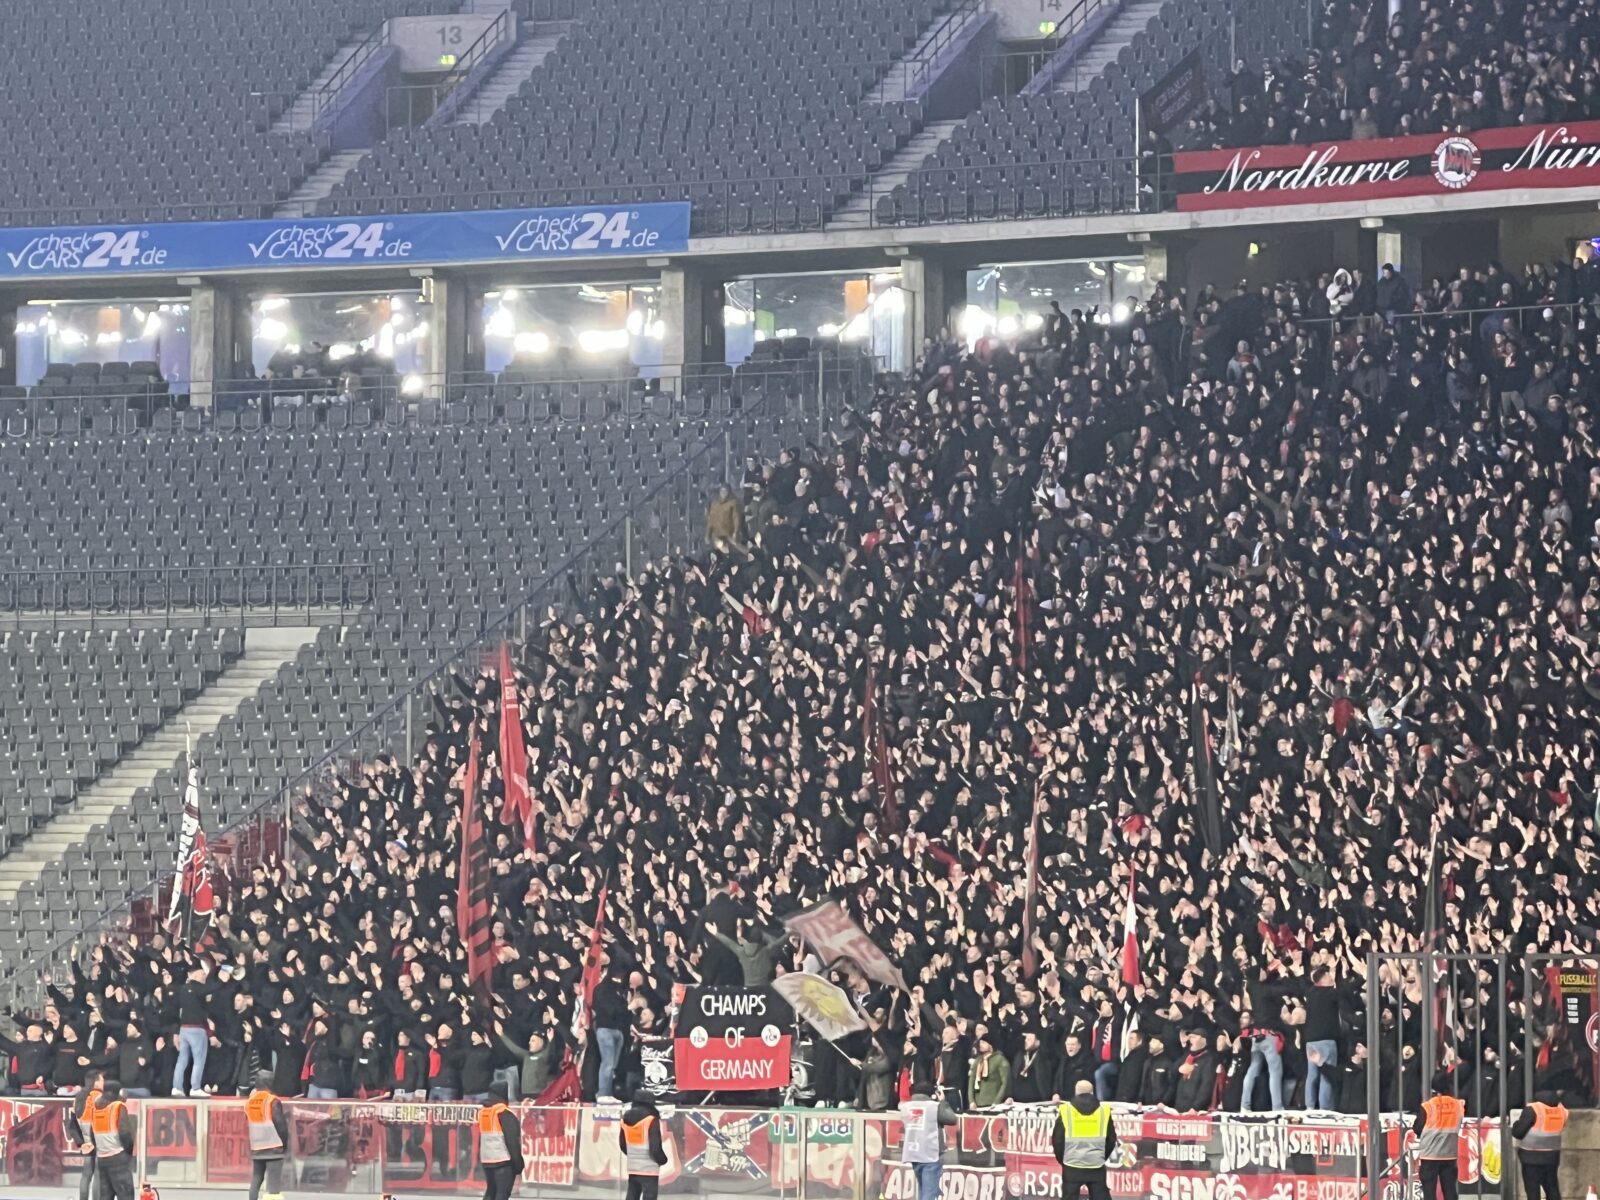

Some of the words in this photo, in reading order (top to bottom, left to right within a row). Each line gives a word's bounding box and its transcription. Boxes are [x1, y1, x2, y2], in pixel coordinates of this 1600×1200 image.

[436, 26, 462, 45] 13
[1203, 145, 1409, 195] Nordkurve
[280, 224, 335, 243] check
[527, 213, 580, 233] check
[38, 232, 91, 251] check
[269, 238, 324, 259] CARS
[516, 231, 571, 252] CARS
[29, 248, 83, 269] CARS
[701, 995, 767, 1016] CHAMPS
[725, 1027, 745, 1048] OF
[700, 1059, 774, 1080] GERMANY
